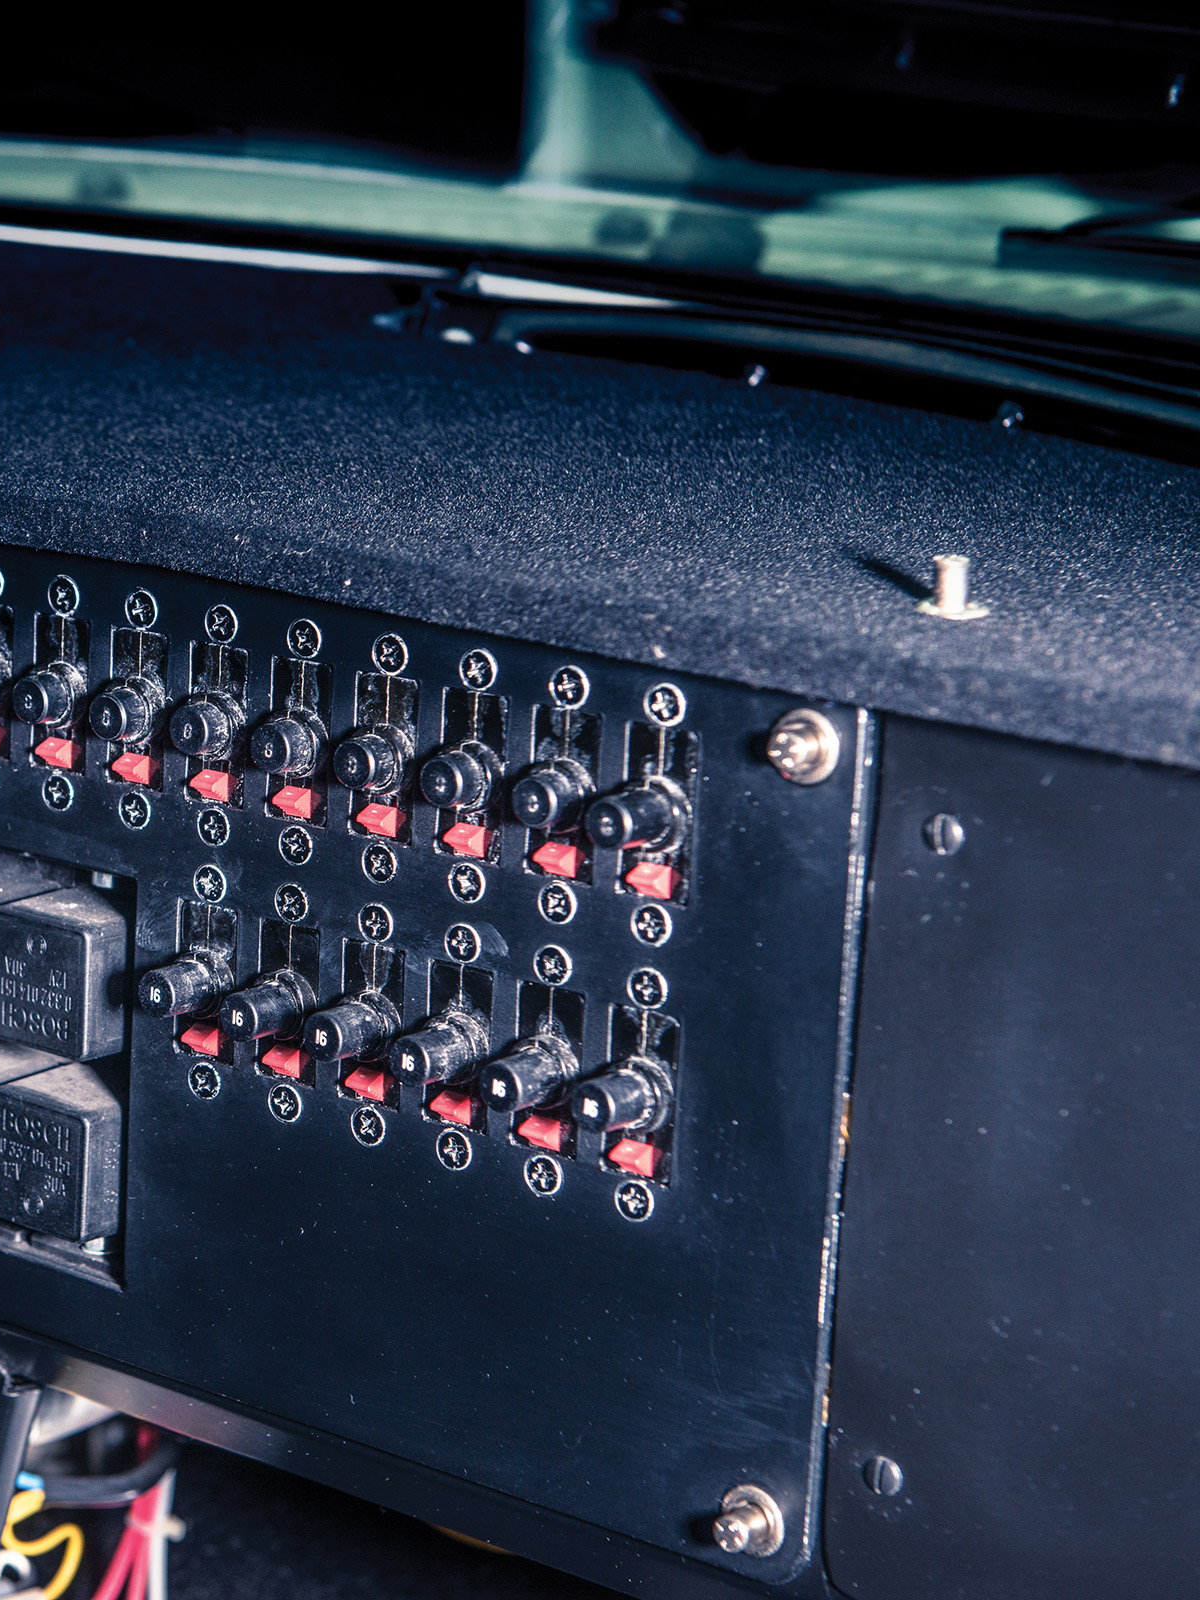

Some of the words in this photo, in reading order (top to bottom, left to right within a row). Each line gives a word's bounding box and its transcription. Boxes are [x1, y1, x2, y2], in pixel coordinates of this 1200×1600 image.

[149, 986, 161, 1003] 16
[1, 1001, 68, 1041] BOSCH
[231, 1009, 244, 1027] 16
[314, 1028, 328, 1047] 16
[401, 1052, 415, 1072] 16
[491, 1078, 507, 1098] 16
[582, 1097, 599, 1118] 16
[2, 1108, 70, 1152] BOSCH
